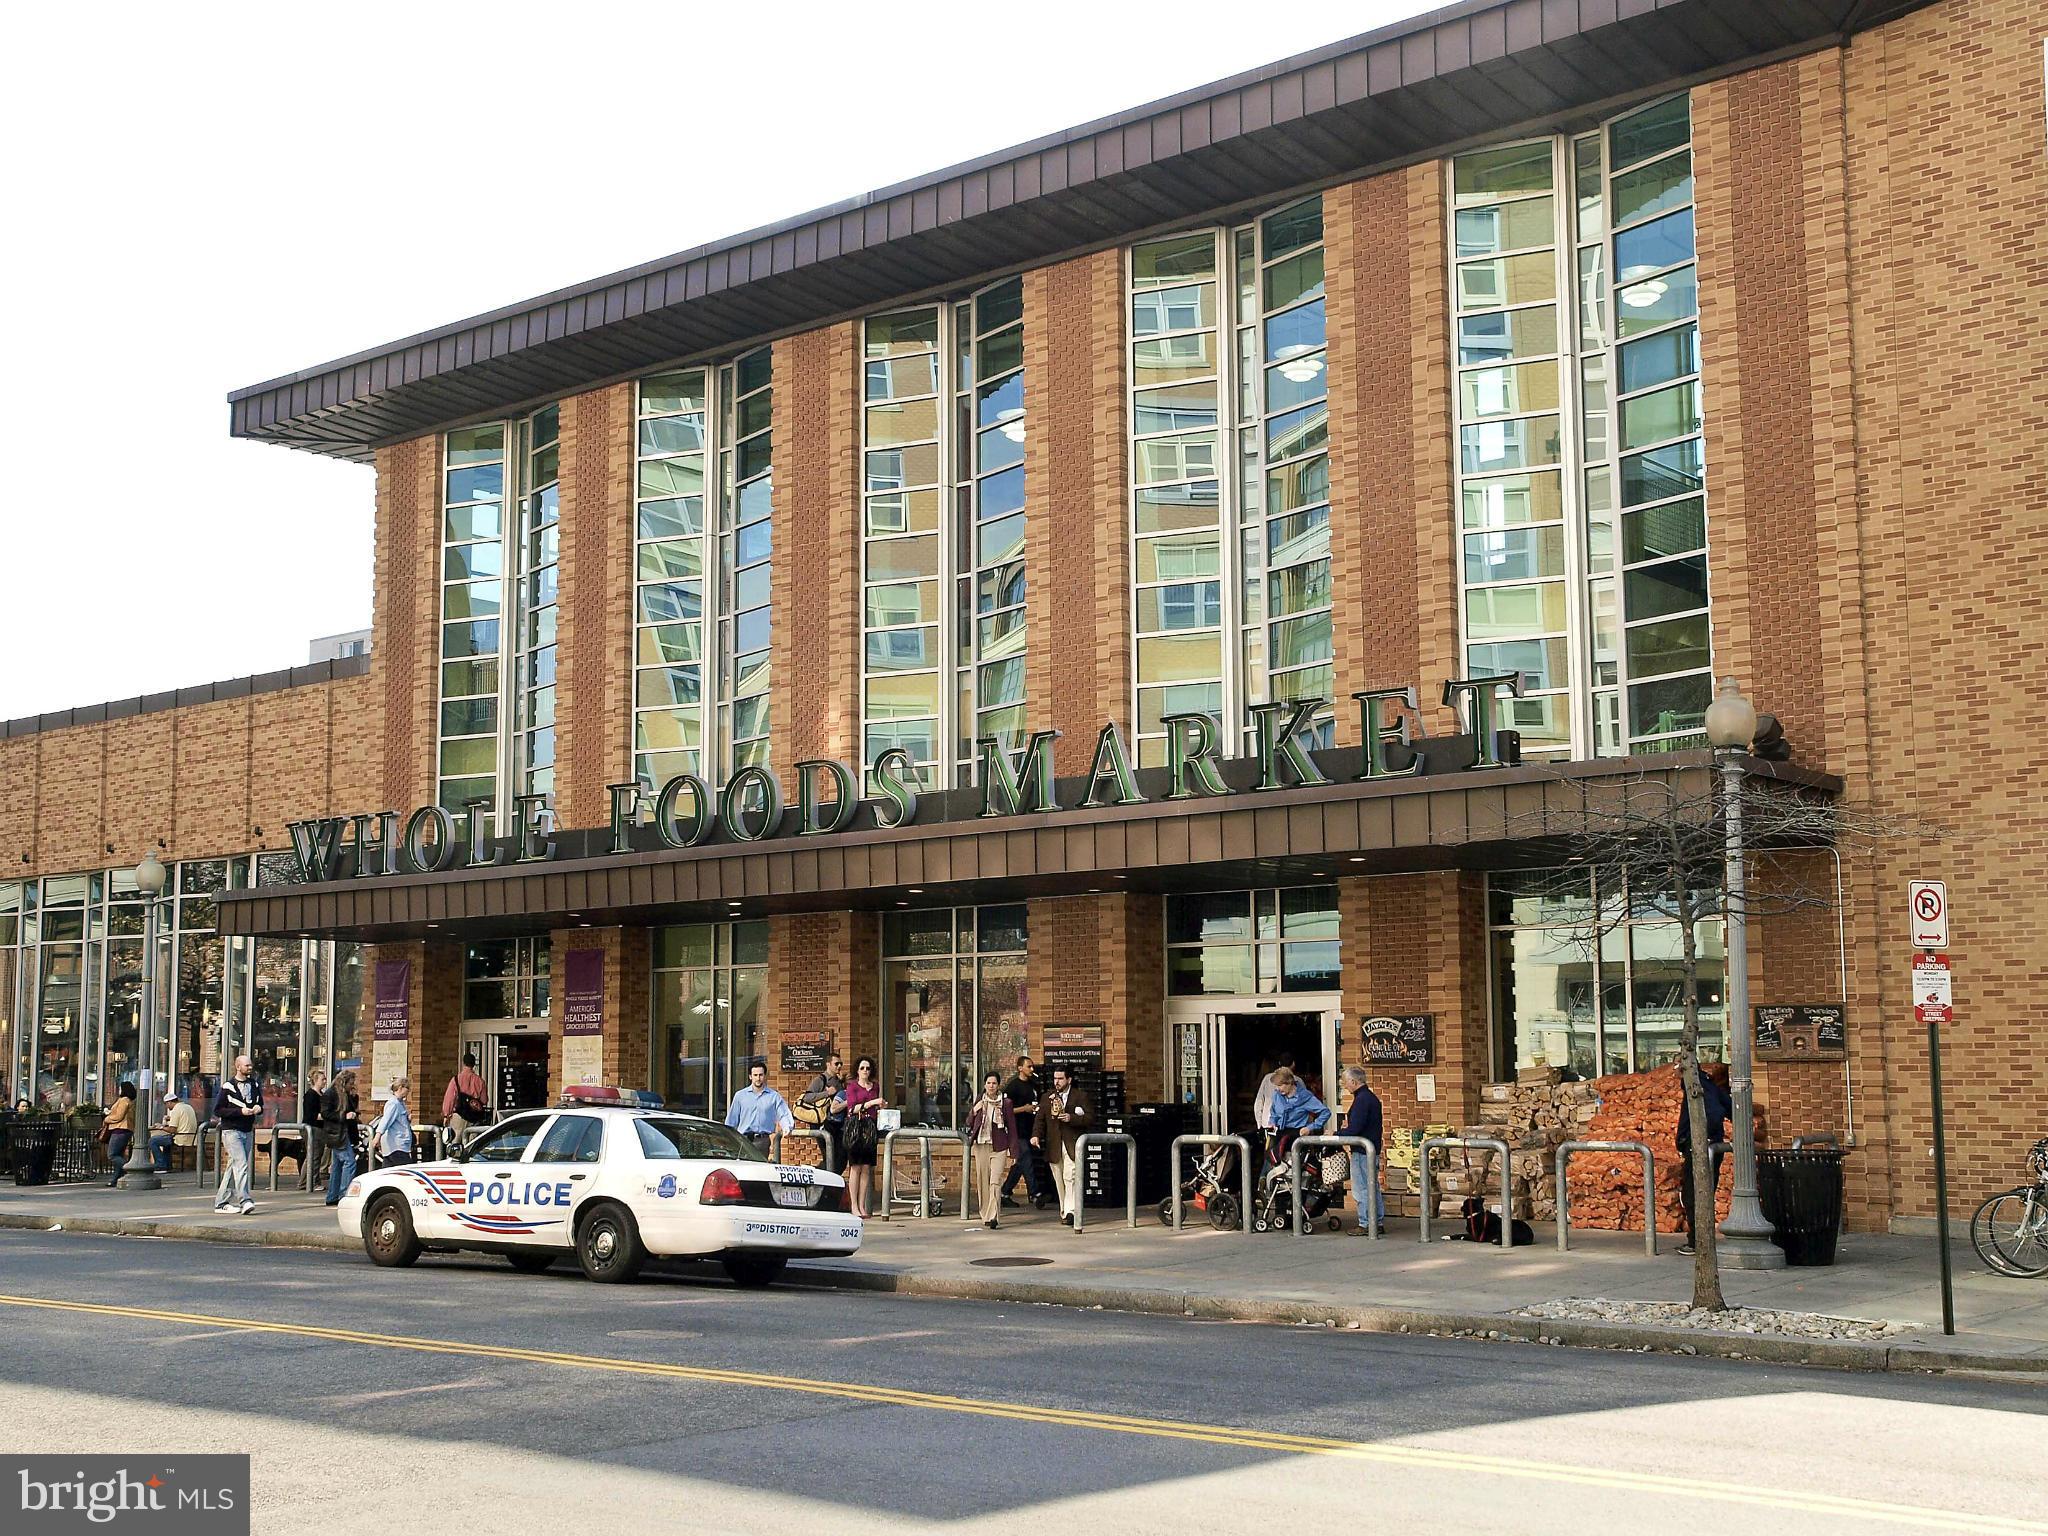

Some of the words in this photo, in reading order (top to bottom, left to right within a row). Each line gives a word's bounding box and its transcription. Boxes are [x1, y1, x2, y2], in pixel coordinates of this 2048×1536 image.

[288, 793, 556, 883] WHOLE
[605, 748, 917, 854] FOODS
[976, 671, 1525, 819] MARKET
[564, 1013, 602, 1022] HEALTHIEST
[374, 1019, 408, 1028] HEALTHIEST
[780, 1172, 815, 1185] POLICE
[468, 1182, 573, 1207] POLICE
[646, 1186, 657, 1194] MP
[411, 1198, 428, 1207] 3042
[759, 1224, 801, 1235] DISTRICT
[840, 1229, 860, 1238] 3042
